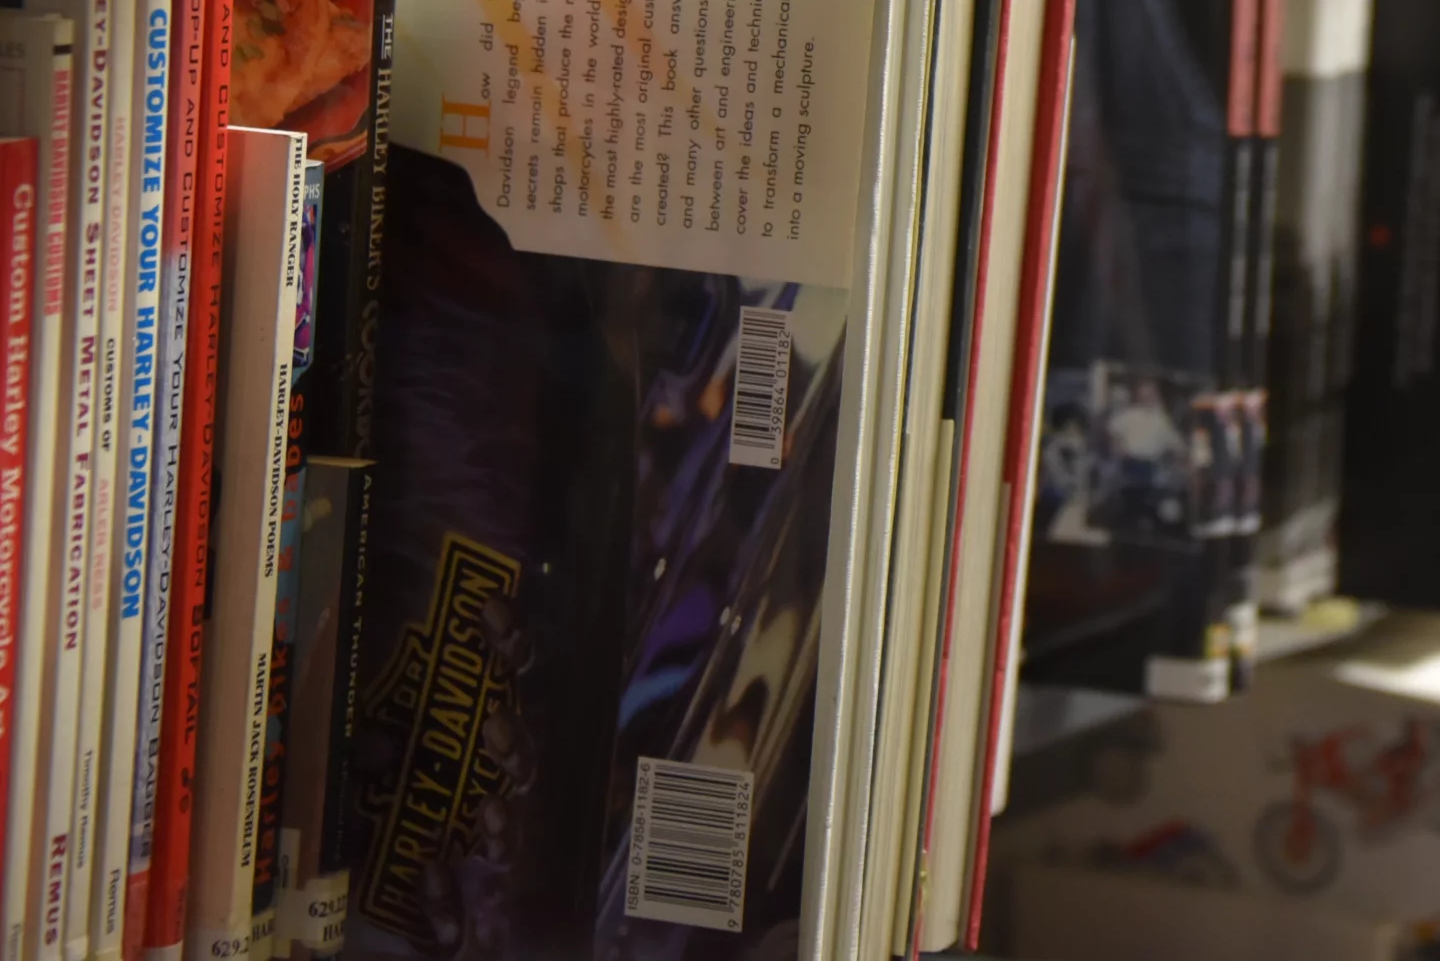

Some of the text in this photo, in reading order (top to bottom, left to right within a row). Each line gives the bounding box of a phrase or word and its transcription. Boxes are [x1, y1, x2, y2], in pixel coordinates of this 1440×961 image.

[219, 3, 231, 68] AND
[382, 13, 394, 59] THE
[478, 21, 495, 52] did
[529, 15, 547, 75] hidden
[557, 13, 574, 40] the
[693, 0, 710, 79] questions
[52, 70, 69, 132] HARLEY
[142, 8, 168, 193] CUSTOMIZE
[501, 43, 521, 105] legend
[555, 47, 572, 119] produce
[581, 57, 598, 84] the
[581, 92, 595, 108] in
[603, 43, 625, 145] highly-rated
[635, 37, 654, 104] original
[659, 49, 678, 92] book
[713, 84, 730, 119] and
[742, 59, 758, 94] and
[184, 98, 195, 158] AND
[373, 67, 393, 174] HARLEY
[530, 85, 543, 144] remain
[551, 125, 568, 158] that
[634, 111, 647, 152] most
[657, 105, 674, 138] This
[684, 86, 702, 131] other
[714, 126, 727, 152] art
[737, 101, 755, 148] ideas
[771, 106, 783, 119] a
[786, 36, 816, 241] into a moving sculpture.
[48, 138, 68, 224] DAVIDSON
[209, 85, 228, 267] CUSTOMIZE
[496, 126, 514, 208] Davidson
[526, 154, 539, 211] secrets
[547, 165, 568, 214] shops
[577, 117, 596, 217] motorcycles
[605, 149, 618, 189] most
[627, 159, 644, 186] the
[655, 152, 671, 227] created?
[685, 138, 702, 187] many
[703, 160, 724, 232] between
[734, 154, 751, 181] the
[761, 130, 781, 210] transform
[107, 117, 126, 312] HARLEY DAVIDSON
[285, 137, 304, 287] THE HOLY RANGER
[599, 194, 615, 220] the
[630, 194, 642, 224] are
[679, 194, 695, 230] and
[736, 187, 749, 236] cover
[760, 221, 774, 238] to
[8, 184, 35, 325] Custom
[81, 222, 101, 318] SHEET
[137, 204, 160, 294] YOUR
[174, 172, 193, 340] CUSTOMIZE
[75, 336, 96, 438] METAL
[776, 329, 791, 379] 01182
[1, 335, 28, 455] Harley
[100, 338, 116, 452] CUSTOMS OF
[169, 351, 185, 431] YOUR
[770, 386, 785, 435] 39864
[121, 306, 155, 619] HARLEY-DAVIDSON
[193, 284, 220, 587] HARLEY-DAVIDSON
[264, 363, 288, 578] HARLEY-DAVIDSON POEMS
[63, 452, 91, 653] FABRICATION
[354, 473, 373, 607] AMERICAN
[149, 444, 178, 724] HARLEY-DAVIDSON
[344, 615, 363, 738] THUNDER
[79, 749, 94, 810] Timothy
[240, 652, 267, 868] MARTIN JACK ROSENBLUM
[140, 737, 158, 858] BAGGER
[727, 781, 750, 928] 9 780785 811824
[44, 833, 68, 947] REMUS
[105, 868, 121, 935] Remus
